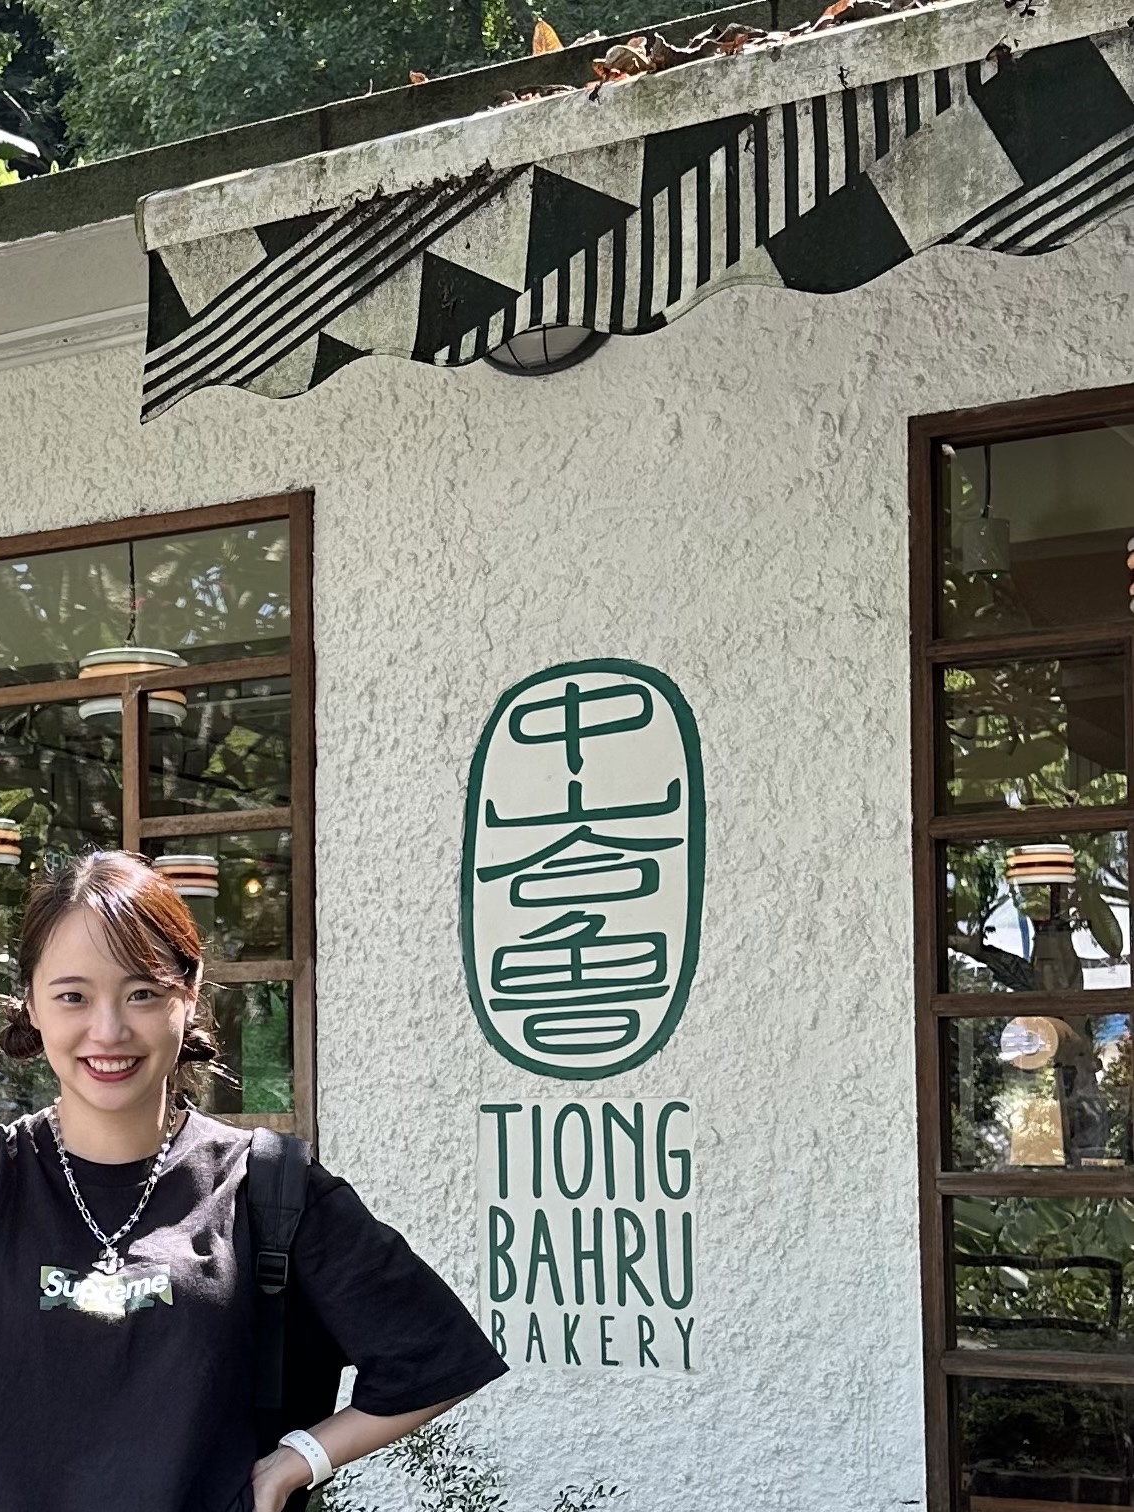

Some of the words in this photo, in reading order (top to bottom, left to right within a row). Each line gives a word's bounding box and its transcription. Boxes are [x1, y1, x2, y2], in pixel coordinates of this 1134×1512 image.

[480, 1101, 692, 1202] TIONG
[489, 1206, 693, 1311] BAHRU
[491, 1308, 695, 1370] BAKERY
